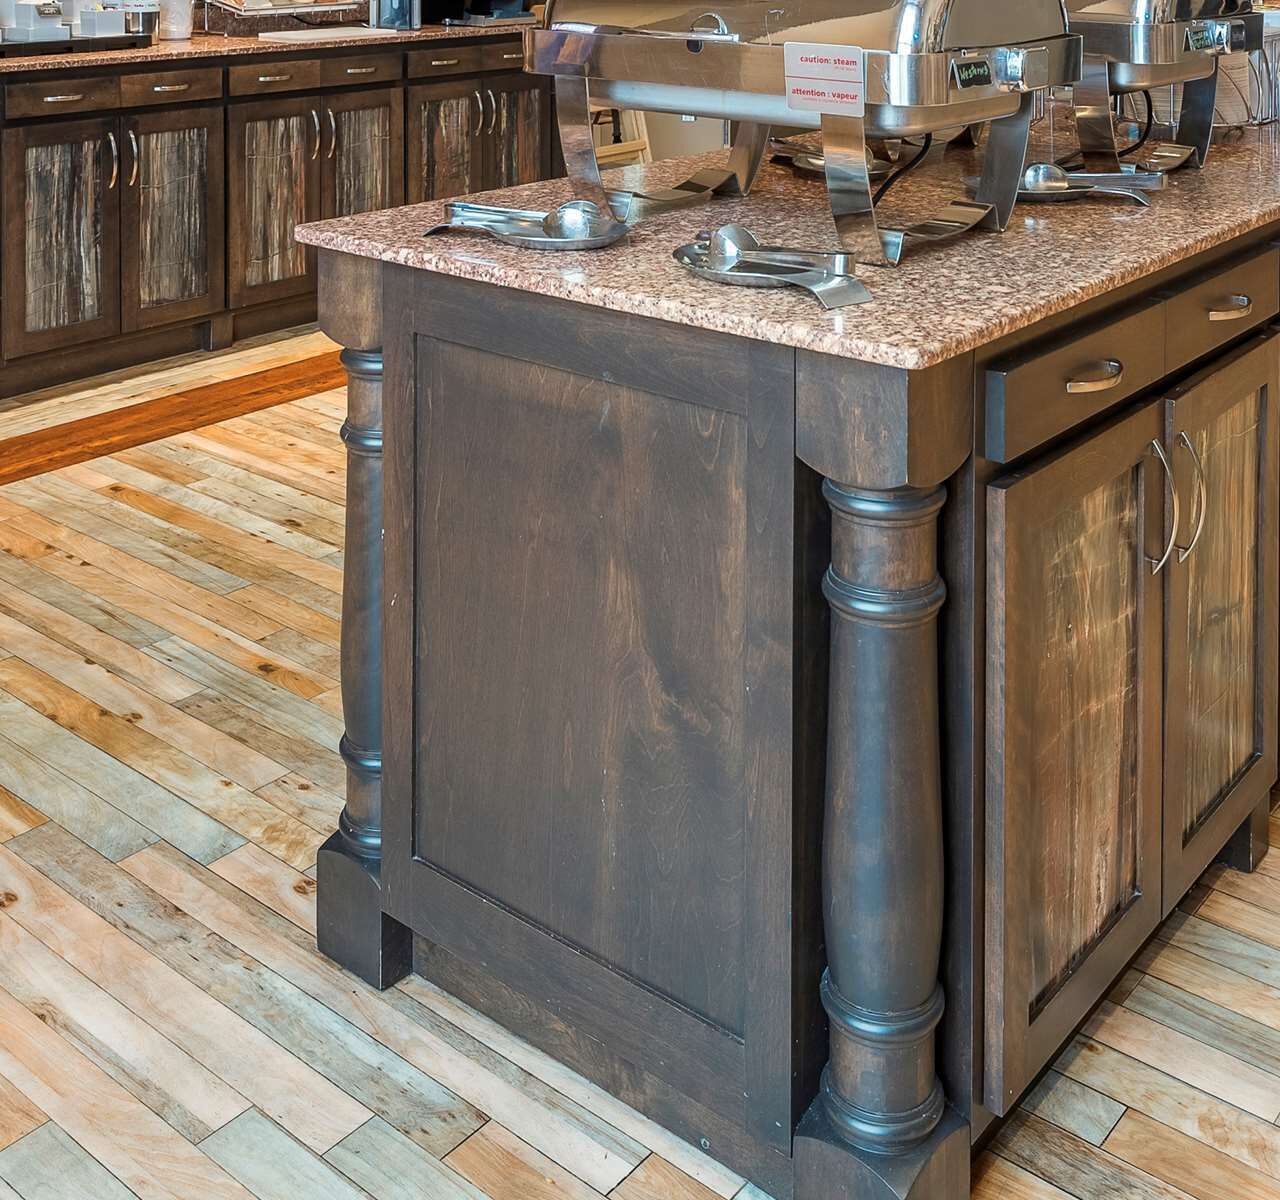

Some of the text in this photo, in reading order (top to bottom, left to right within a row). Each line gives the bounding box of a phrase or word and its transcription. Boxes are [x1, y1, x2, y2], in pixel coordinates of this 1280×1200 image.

[799, 55, 858, 66] caution: steam
[791, 86, 826, 97] attention
[831, 90, 859, 101] vapeur
